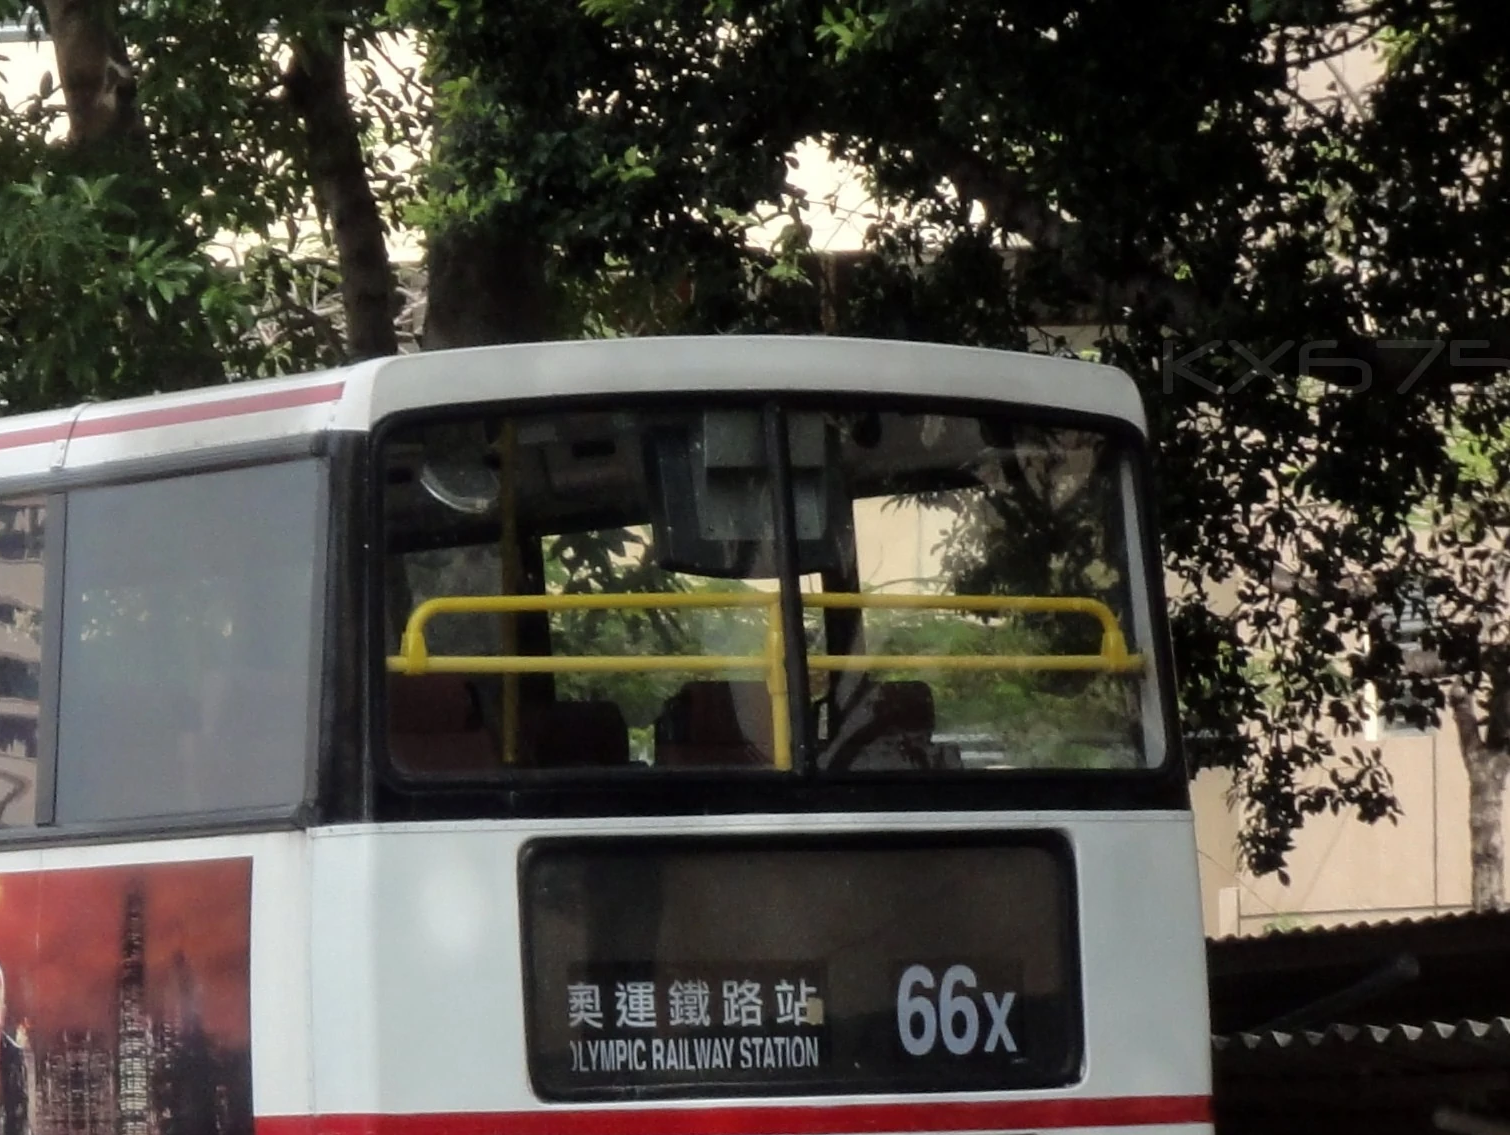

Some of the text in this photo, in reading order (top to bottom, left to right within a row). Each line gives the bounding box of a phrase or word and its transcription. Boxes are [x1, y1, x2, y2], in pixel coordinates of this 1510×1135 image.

[567, 979, 818, 1029] 奧運鐵路站
[652, 1037, 734, 1071] RAILWAY
[740, 1035, 820, 1069] STATION
